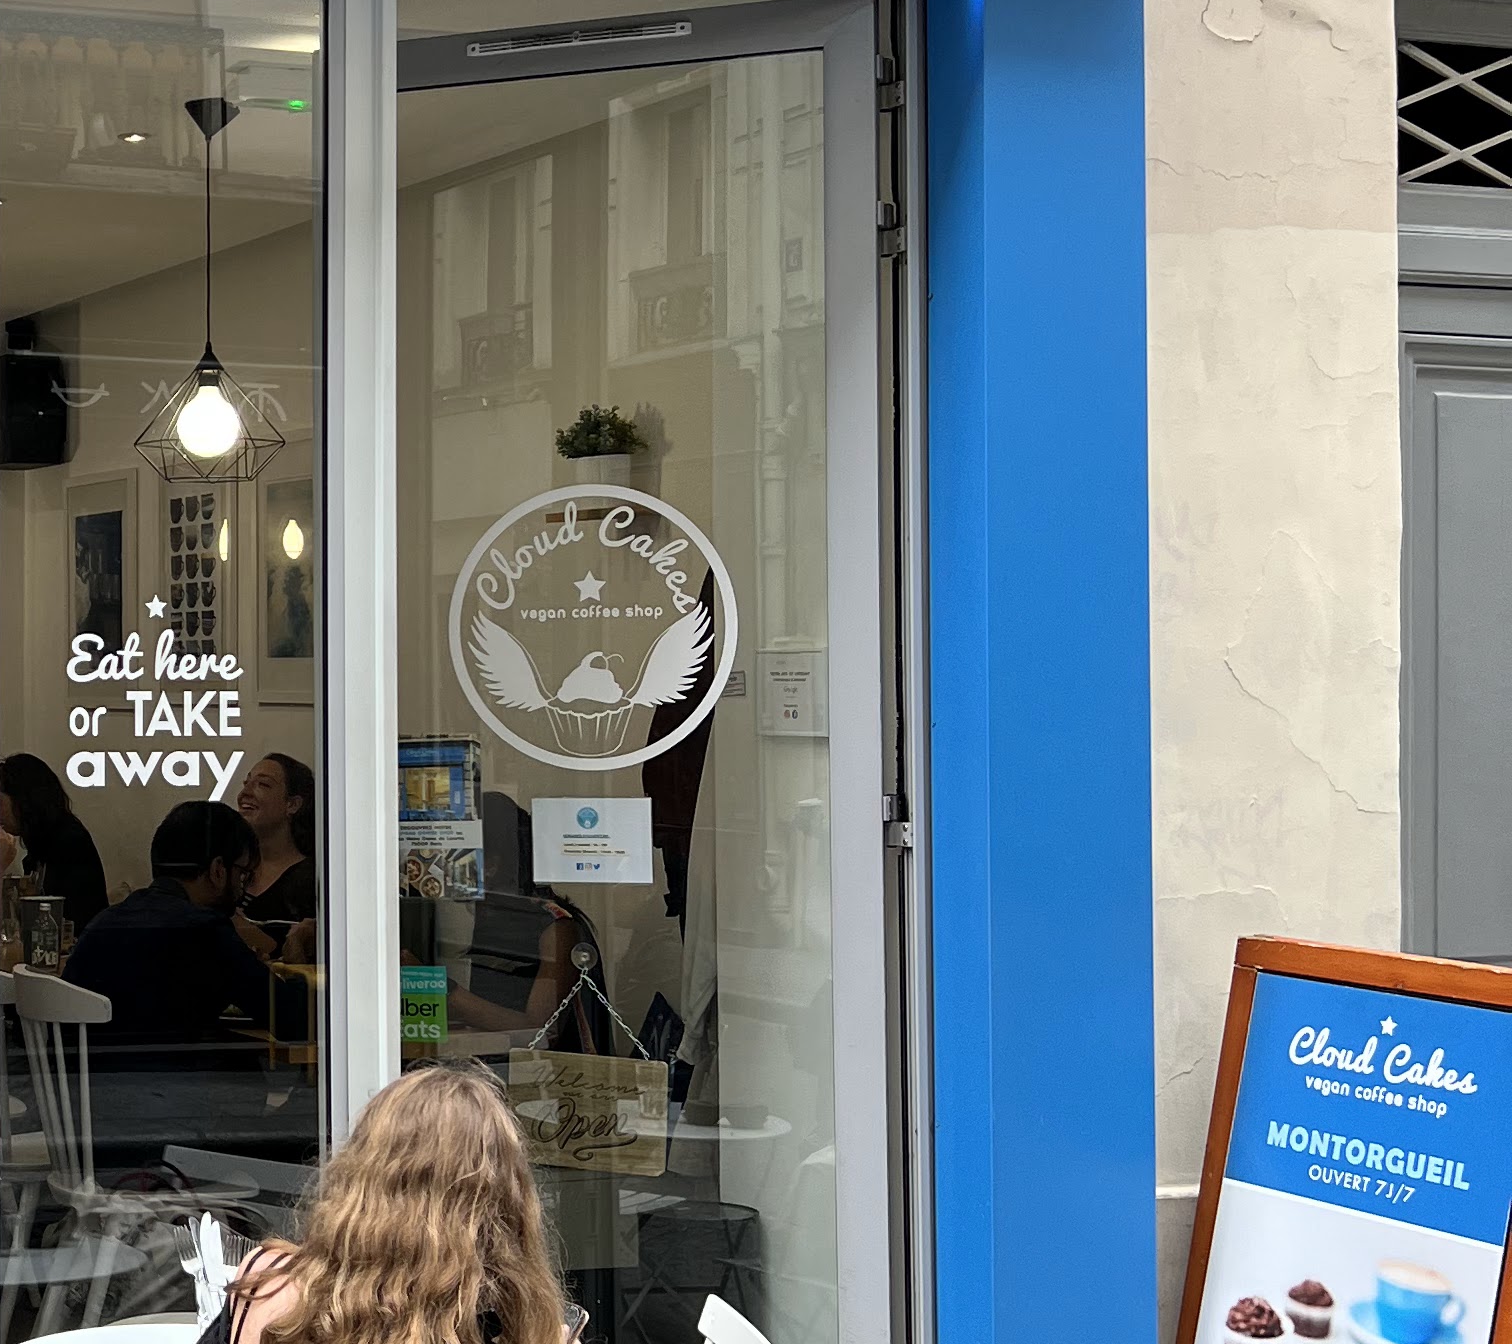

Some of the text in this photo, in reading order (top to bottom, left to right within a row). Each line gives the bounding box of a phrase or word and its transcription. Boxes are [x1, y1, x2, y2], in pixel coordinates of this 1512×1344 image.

[477, 501, 697, 613] Cloud Cakes
[520, 604, 663, 622] vegan coffee shop
[66, 629, 244, 682] Eat here
[69, 690, 242, 737] or TAKE
[66, 750, 244, 802] away
[401, 1020, 441, 1039] ats
[529, 1066, 646, 1096] Welcome
[1289, 1026, 1478, 1094] Cloud Cakes
[1305, 1074, 1447, 1119] vegan coffee shop
[532, 1097, 637, 1161] Open
[1266, 1120, 1470, 1191] MONTORGUEIL
[1308, 1164, 1371, 1194] OUVERT
